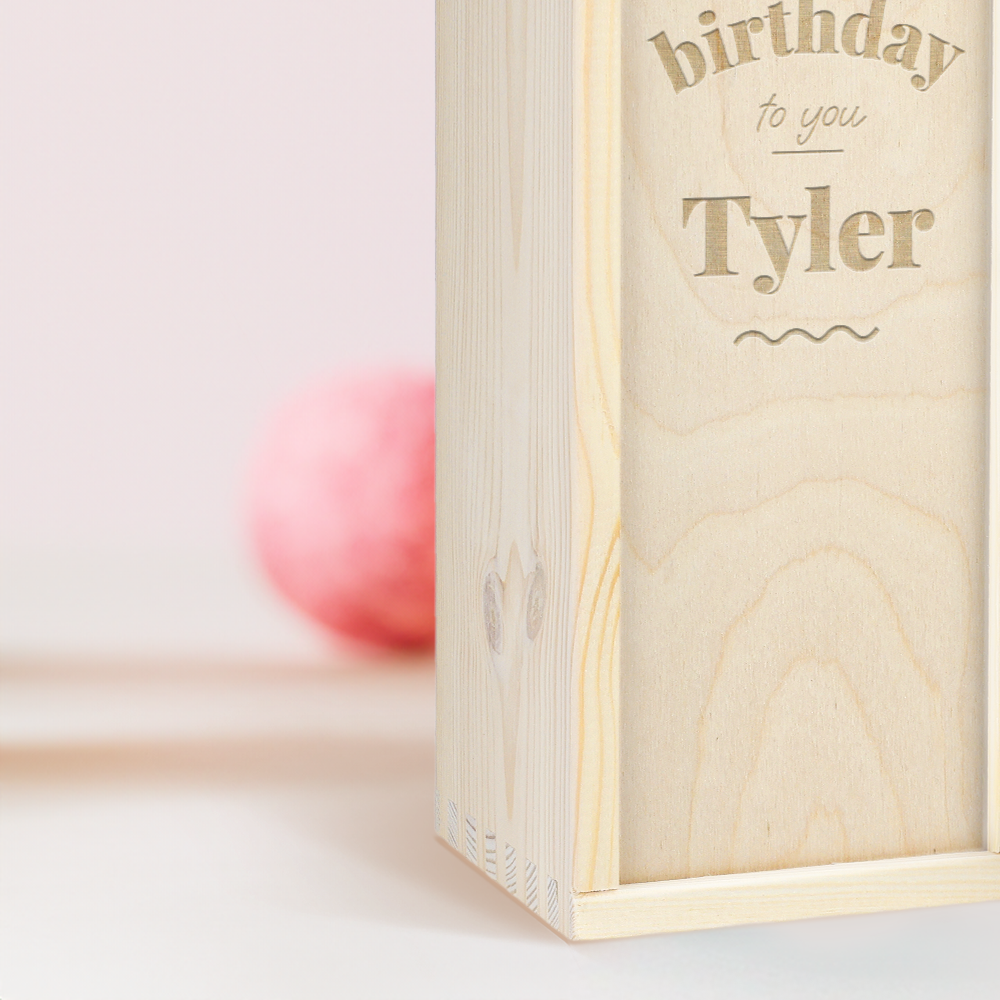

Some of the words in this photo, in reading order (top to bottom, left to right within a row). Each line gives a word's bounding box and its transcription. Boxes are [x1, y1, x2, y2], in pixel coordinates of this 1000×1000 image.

[756, 93, 787, 132] to
[796, 105, 868, 146] you
[682, 185, 936, 295] Tyler
